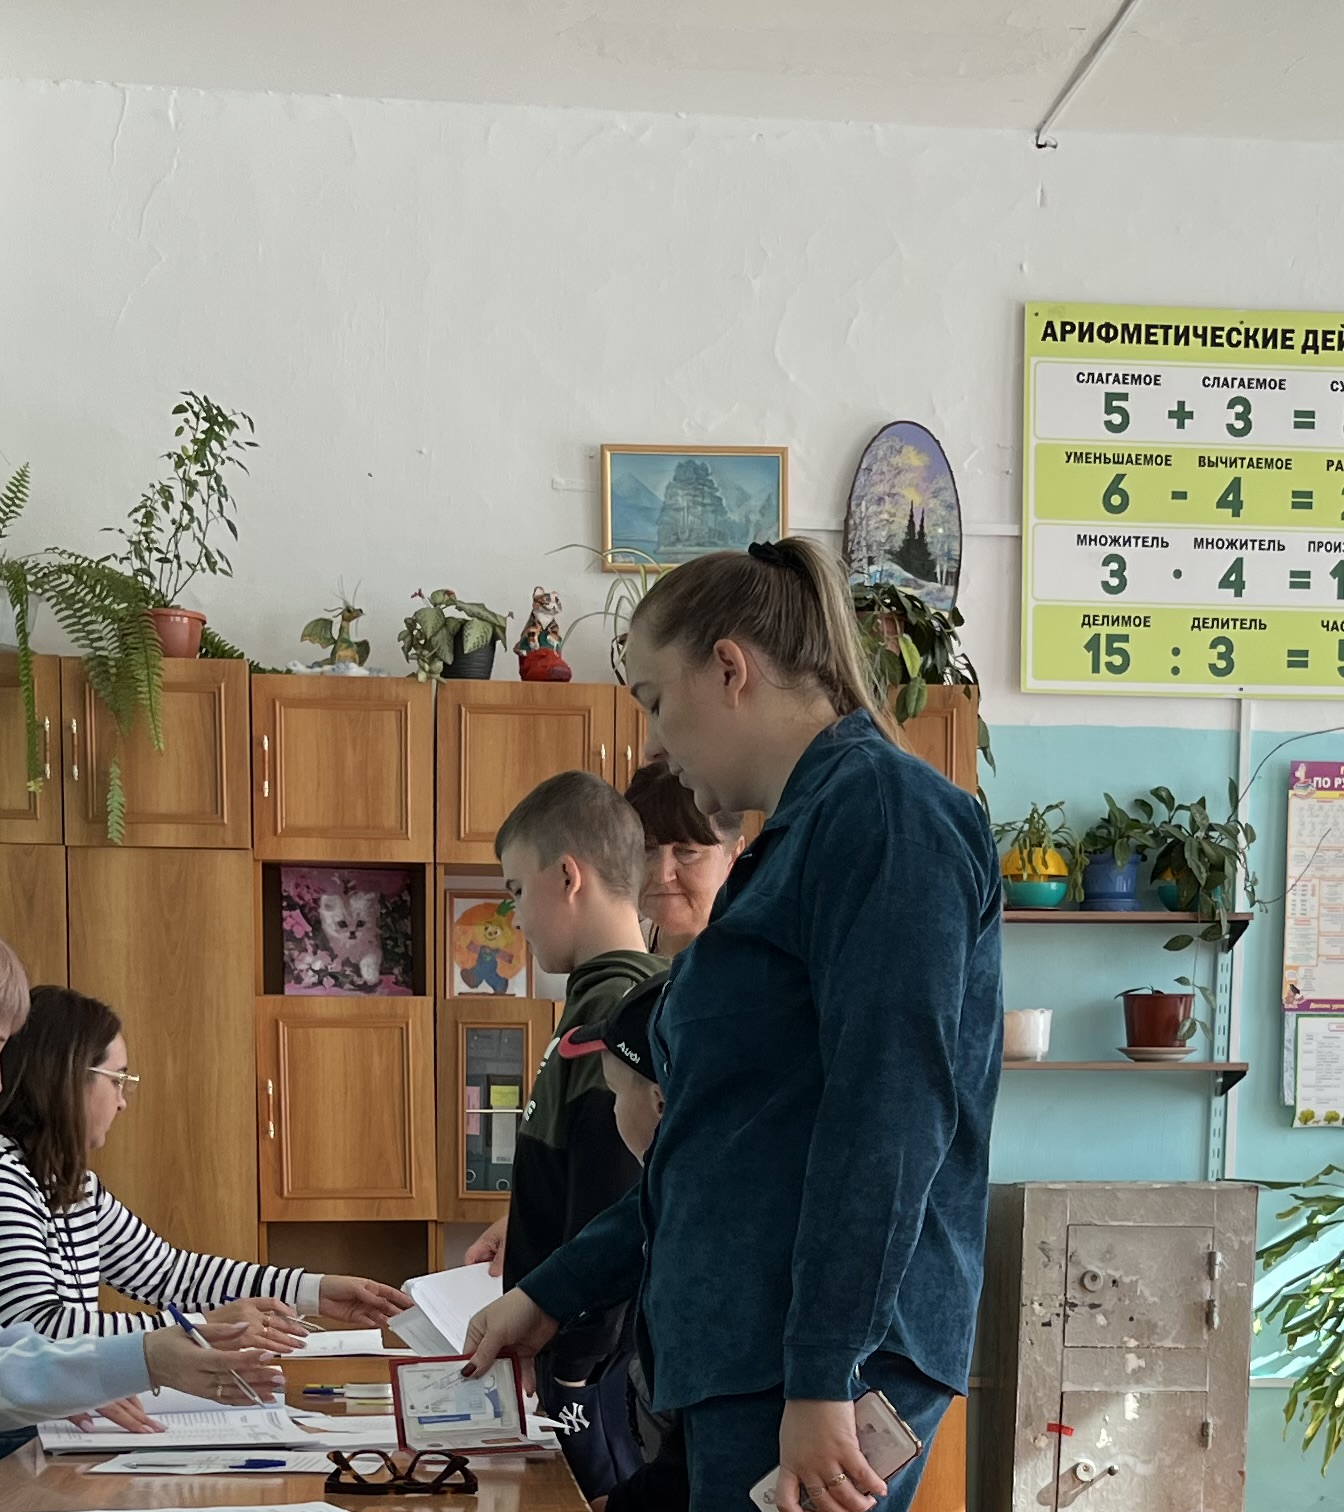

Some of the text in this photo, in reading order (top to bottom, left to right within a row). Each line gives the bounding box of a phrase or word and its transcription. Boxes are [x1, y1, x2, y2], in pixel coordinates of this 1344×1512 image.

[1040, 321, 1295, 350] АРИФМЕТИЧЕСКИЕ
[1076, 372, 1161, 386] СЛАГАЕМОЕ
[1202, 376, 1286, 390] СЛАГАЕМОЕ
[1104, 392, 1130, 433] 5
[1226, 396, 1252, 437] 3
[1065, 452, 1172, 466] УМЕНЬШАЕМОЕ
[1199, 456, 1292, 470] ВЫЧИТАЕМОЕ
[1102, 474, 1129, 514] 6
[1216, 477, 1243, 517] 4
[1077, 534, 1169, 548] МНОЖИТЕЛЬ
[1194, 538, 1285, 551] МНОЖИТЕЛЬ
[1101, 554, 1127, 595] 3
[1218, 557, 1245, 597] 4
[1081, 615, 1151, 628] ДЕЛИМОЕ
[1191, 617, 1267, 631] ДЕЛИТЕЛЬ
[1084, 633, 1130, 674] 15
[1208, 636, 1234, 677] 3
[1313, 777, 1331, 788] ПО
